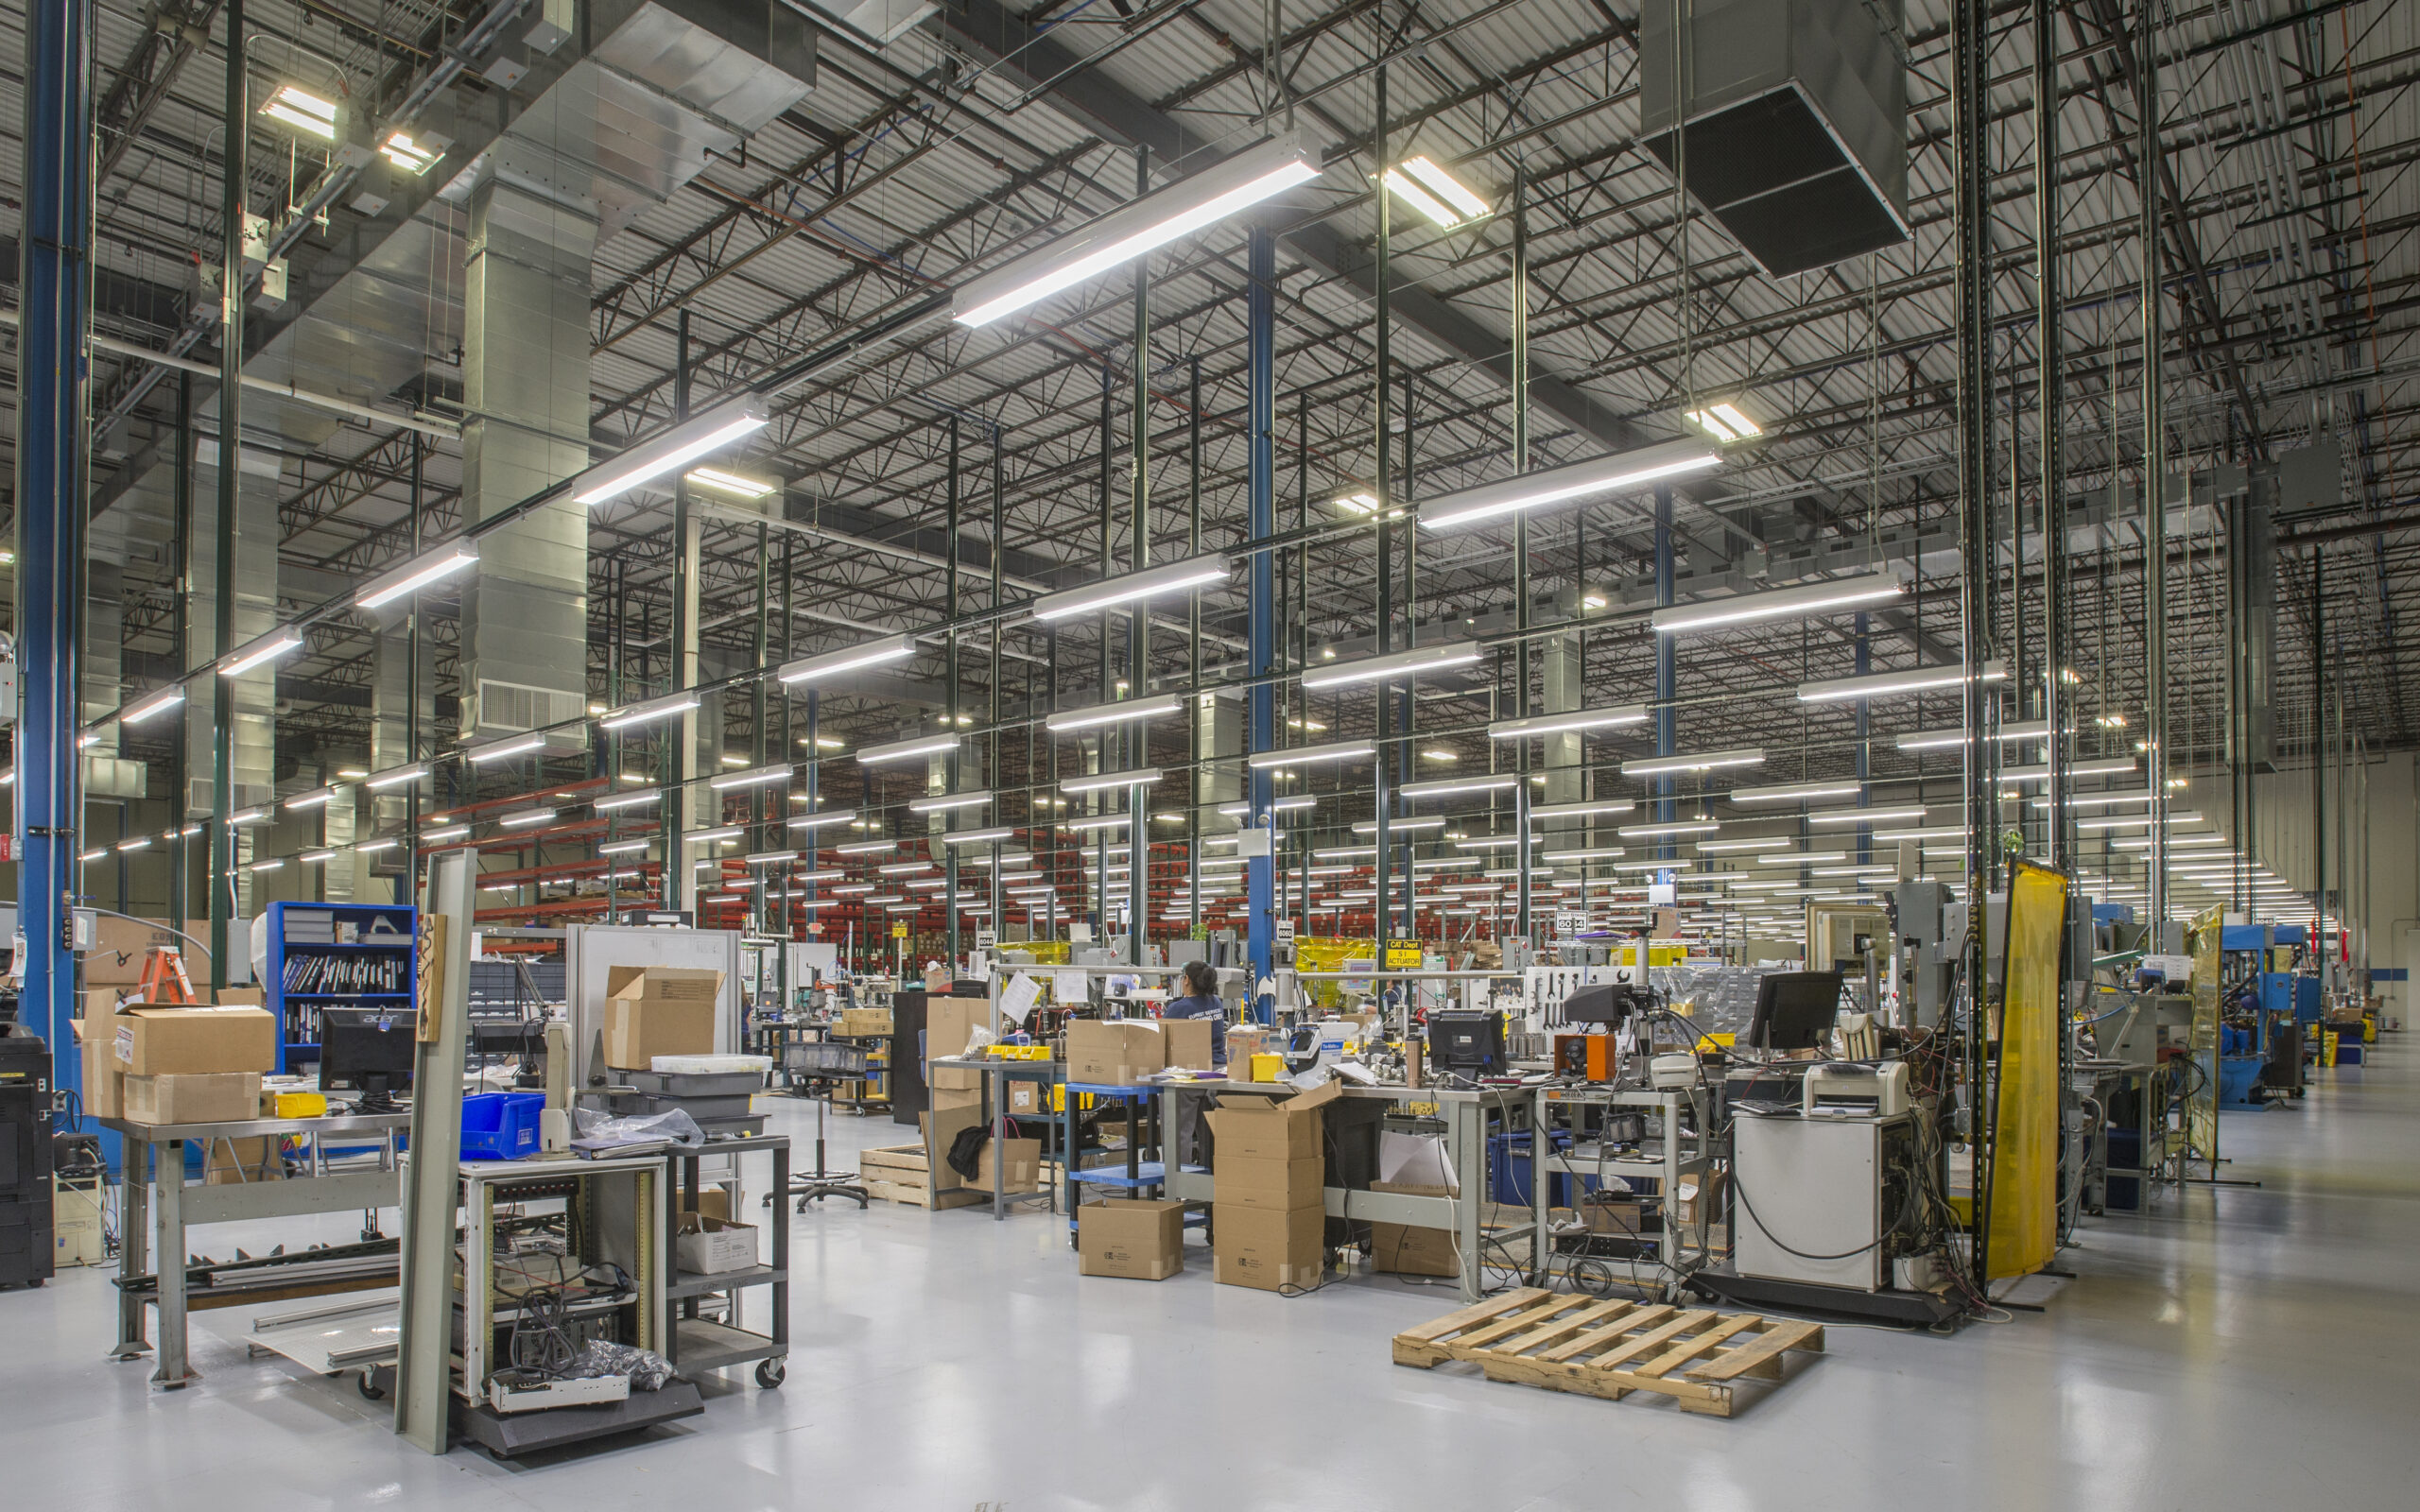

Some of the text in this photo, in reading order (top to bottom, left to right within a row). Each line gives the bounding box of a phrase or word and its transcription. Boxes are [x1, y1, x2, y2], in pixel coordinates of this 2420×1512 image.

[1559, 919, 1584, 928] 604
[1404, 941, 1418, 950] Dept
[363, 1014, 398, 1023] acer
